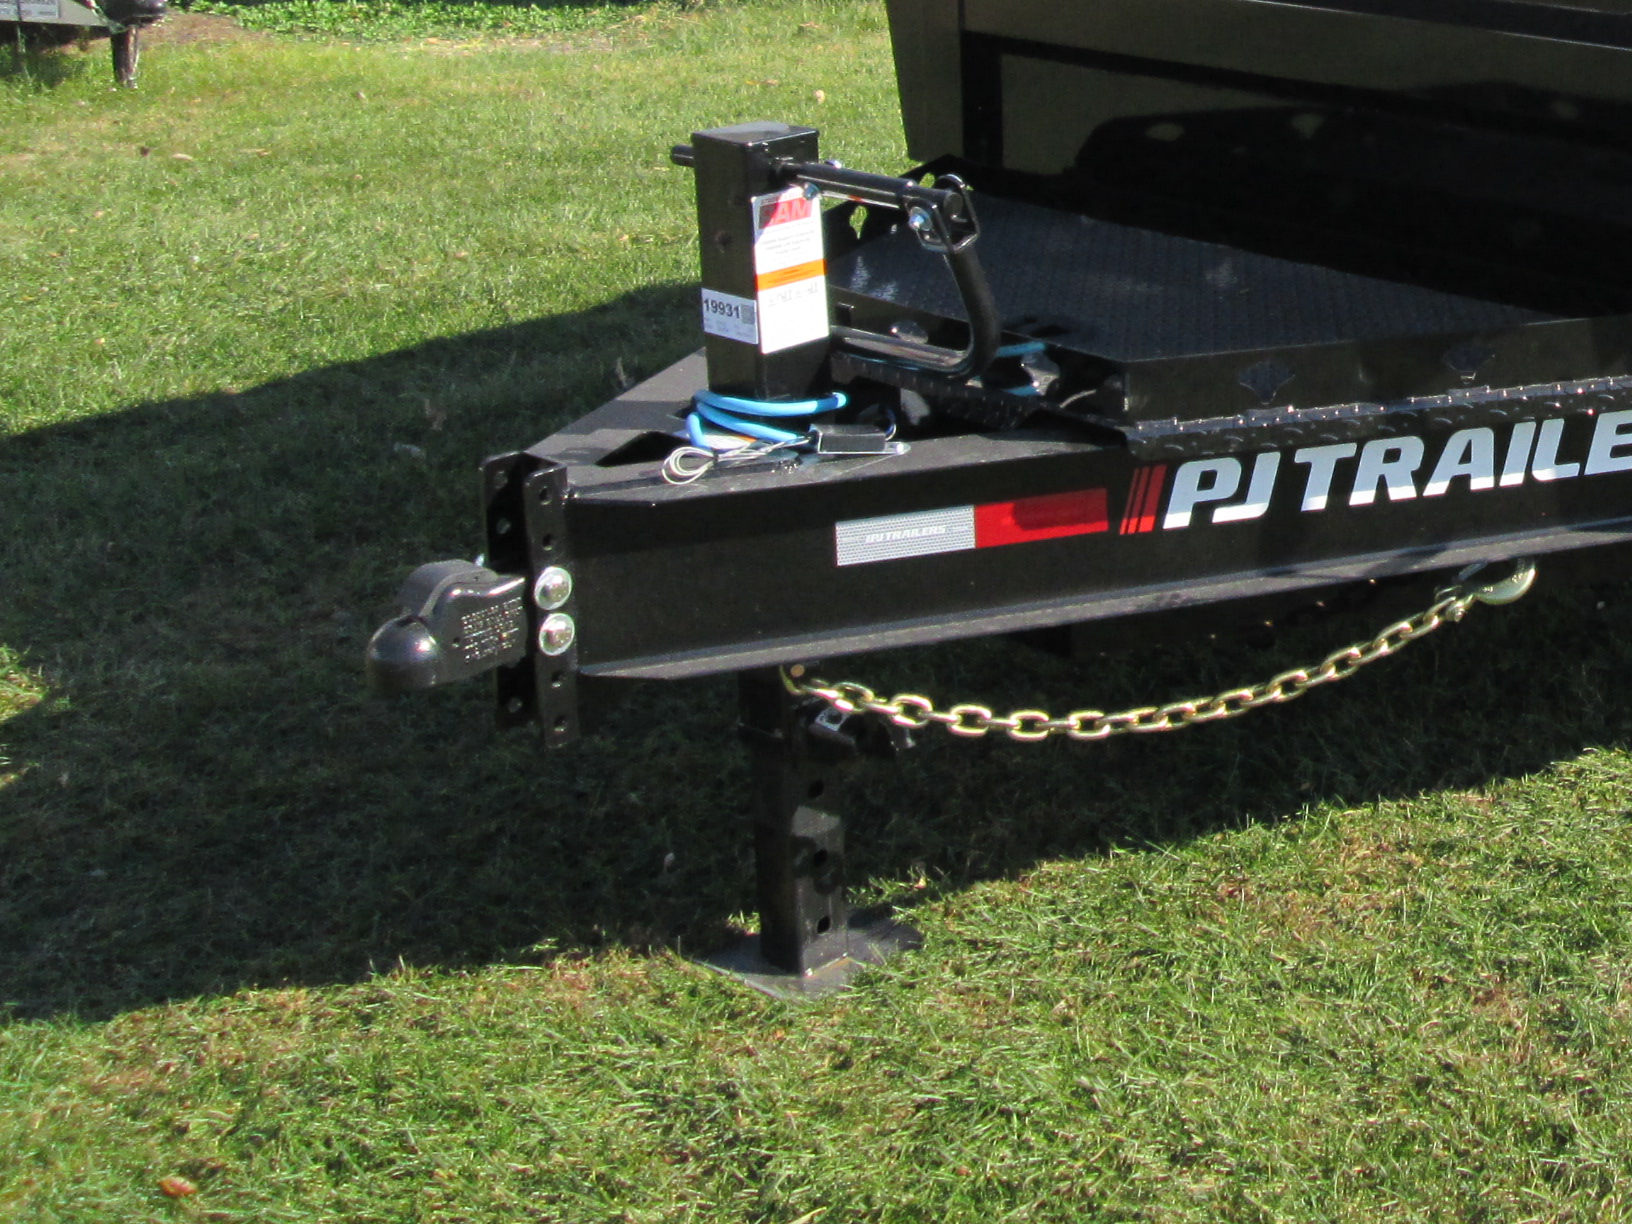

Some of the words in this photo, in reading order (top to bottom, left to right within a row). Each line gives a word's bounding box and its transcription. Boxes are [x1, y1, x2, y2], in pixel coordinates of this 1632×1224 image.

[703, 298, 740, 319] 19931
[1162, 451, 1281, 530] PJ
[885, 524, 947, 541] TRAILERS
